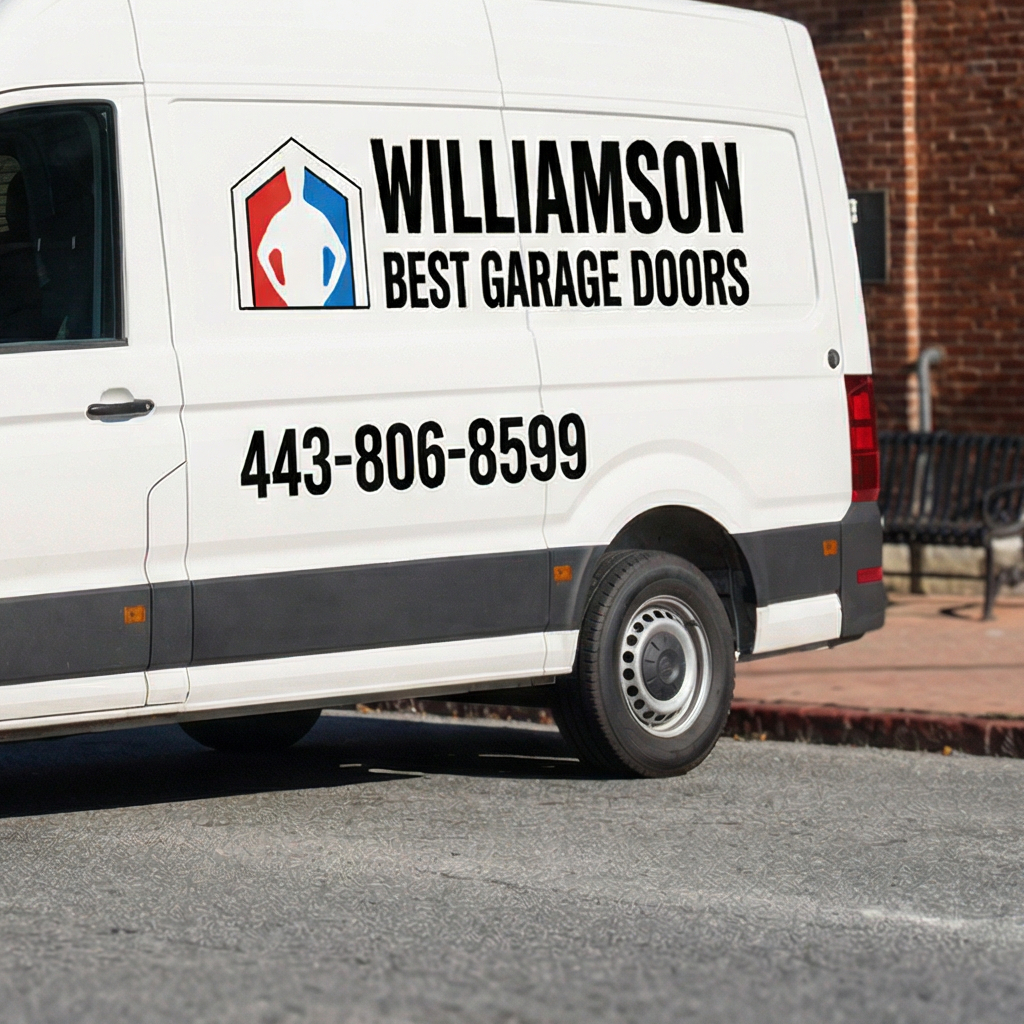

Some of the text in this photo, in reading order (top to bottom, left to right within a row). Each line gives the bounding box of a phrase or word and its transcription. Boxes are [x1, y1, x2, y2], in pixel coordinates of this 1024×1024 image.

[370, 138, 744, 235] WILLIAMSON
[383, 248, 750, 309] BEST GARAGE DOORS
[240, 412, 587, 499] 443-806-8599
